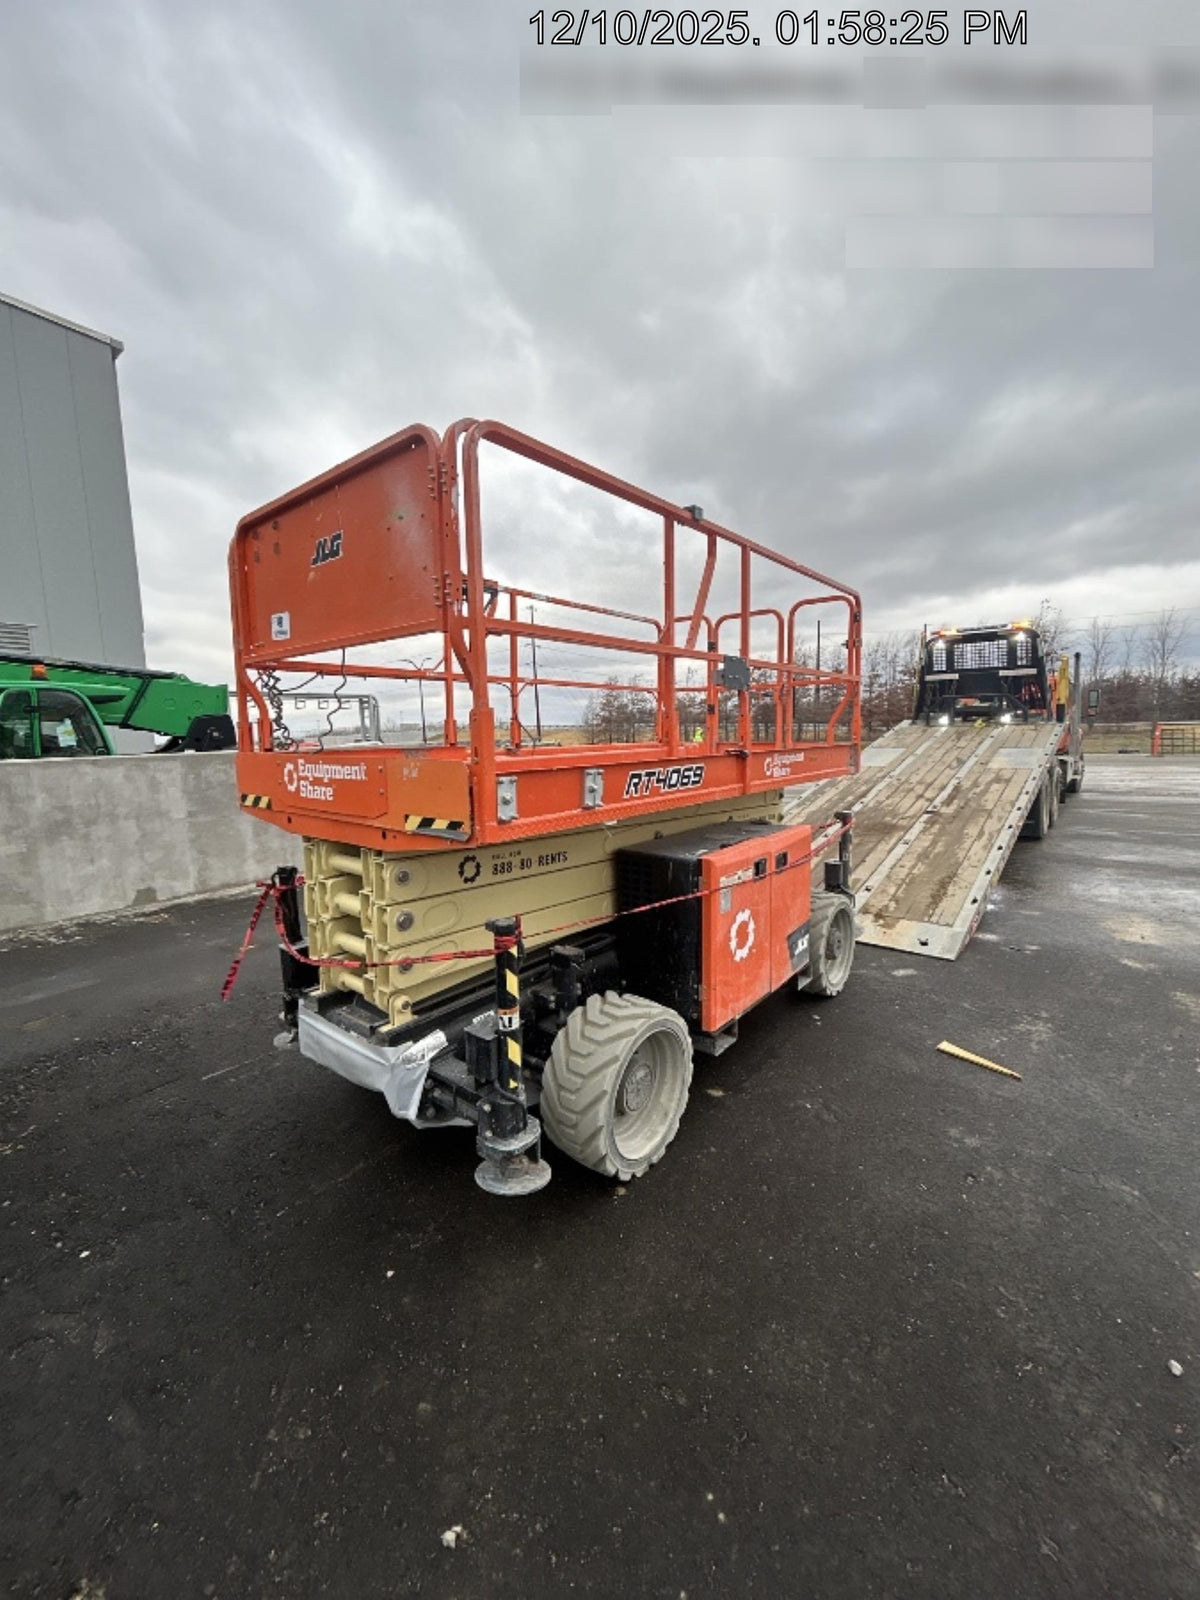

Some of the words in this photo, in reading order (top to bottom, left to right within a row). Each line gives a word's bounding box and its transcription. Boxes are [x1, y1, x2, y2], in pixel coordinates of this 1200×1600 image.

[311, 530, 343, 567] JLG
[298, 759, 367, 783] Equipment
[623, 764, 705, 798] RT4069
[300, 780, 334, 801] Share
